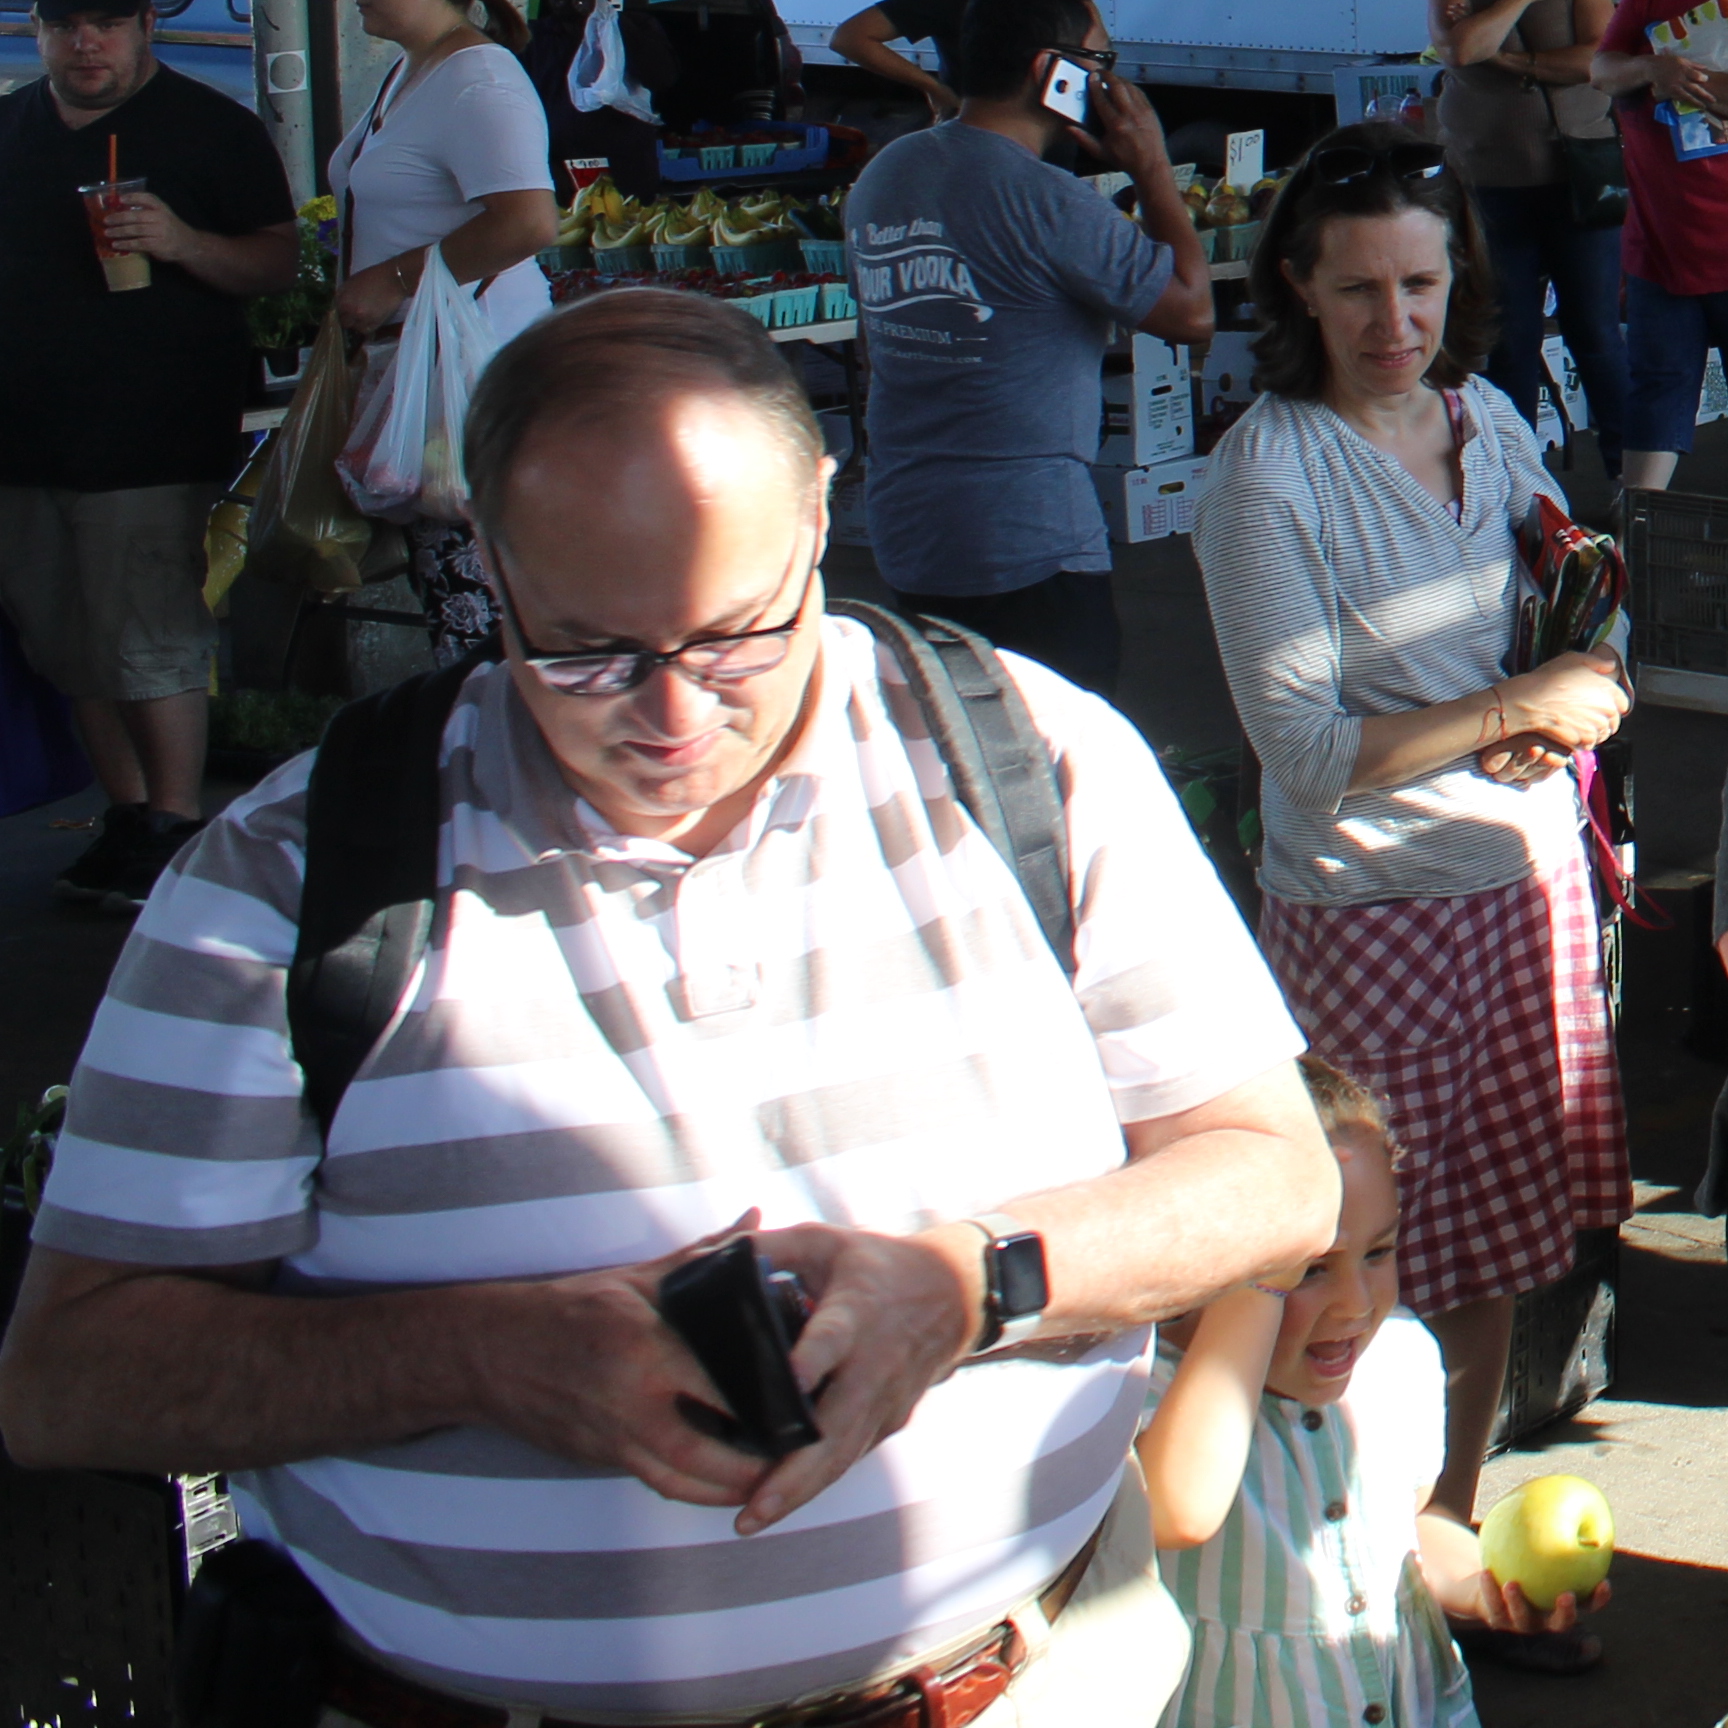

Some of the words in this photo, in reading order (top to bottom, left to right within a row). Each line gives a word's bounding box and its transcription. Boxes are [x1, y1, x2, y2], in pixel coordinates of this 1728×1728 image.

[866, 222, 907, 246] Better
[908, 217, 943, 237] than
[898, 255, 983, 302] VODKA
[883, 322, 952, 344] PREMIUM
